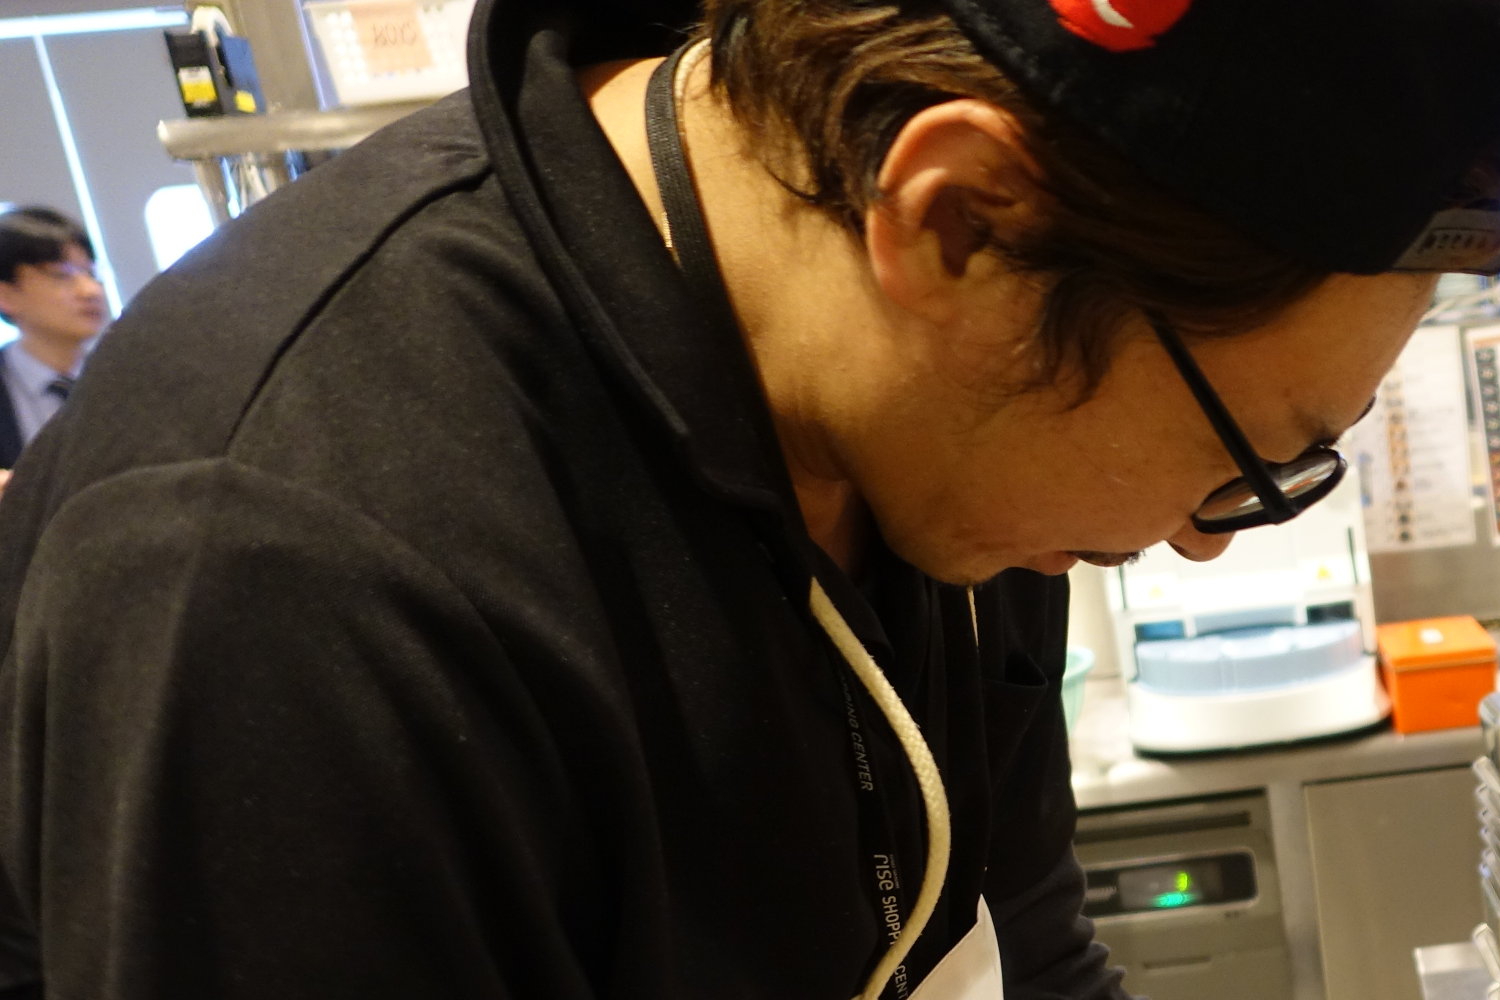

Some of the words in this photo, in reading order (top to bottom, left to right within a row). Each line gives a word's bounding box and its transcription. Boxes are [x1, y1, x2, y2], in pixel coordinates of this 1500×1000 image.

[851, 731, 873, 791] CENTER
[874, 854, 894, 891] rise
[882, 895, 901, 945] SHOPP
[894, 965, 909, 1000] CENT
